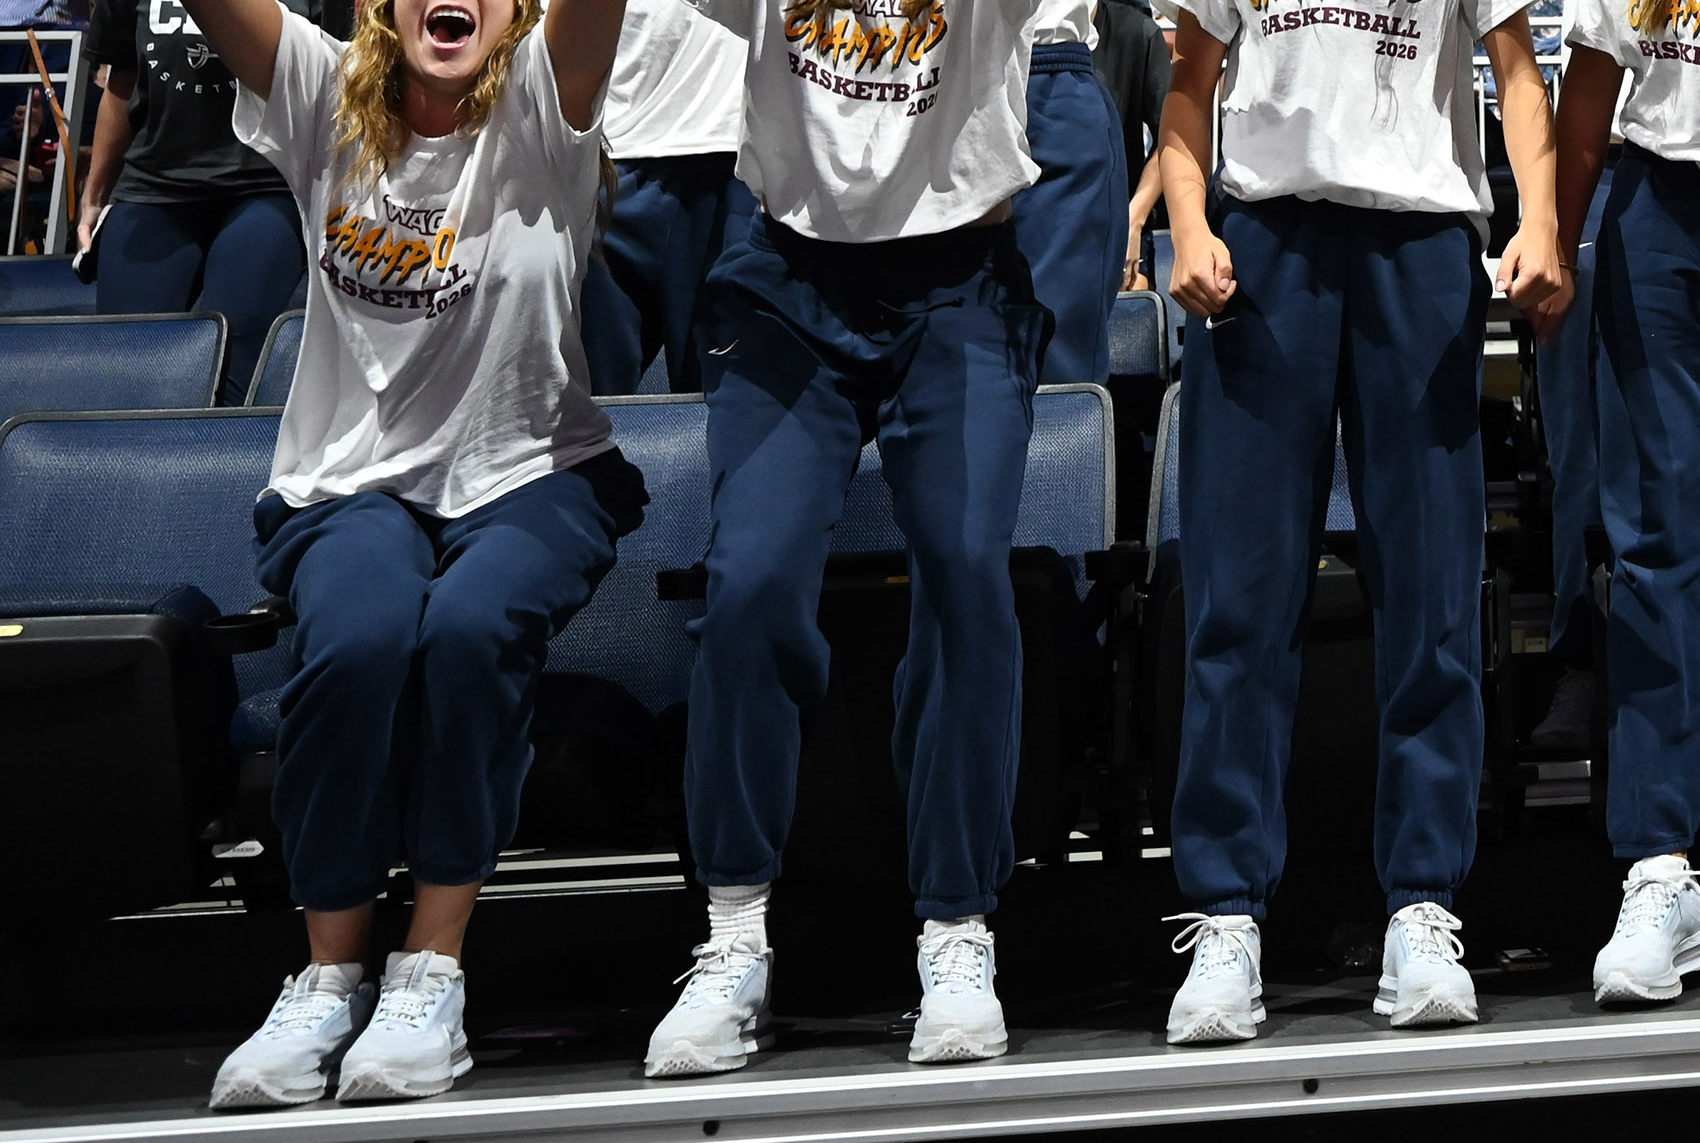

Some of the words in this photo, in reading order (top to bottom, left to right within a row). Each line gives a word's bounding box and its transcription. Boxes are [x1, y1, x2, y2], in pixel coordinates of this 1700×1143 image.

[1261, 7, 1421, 39] BASKETBALL
[1375, 40, 1417, 60] 2026
[146, 43, 237, 94] BASKETB
[788, 51, 940, 102] BASKETBLL
[907, 91, 938, 117] 202
[425, 283, 472, 319] 2026
